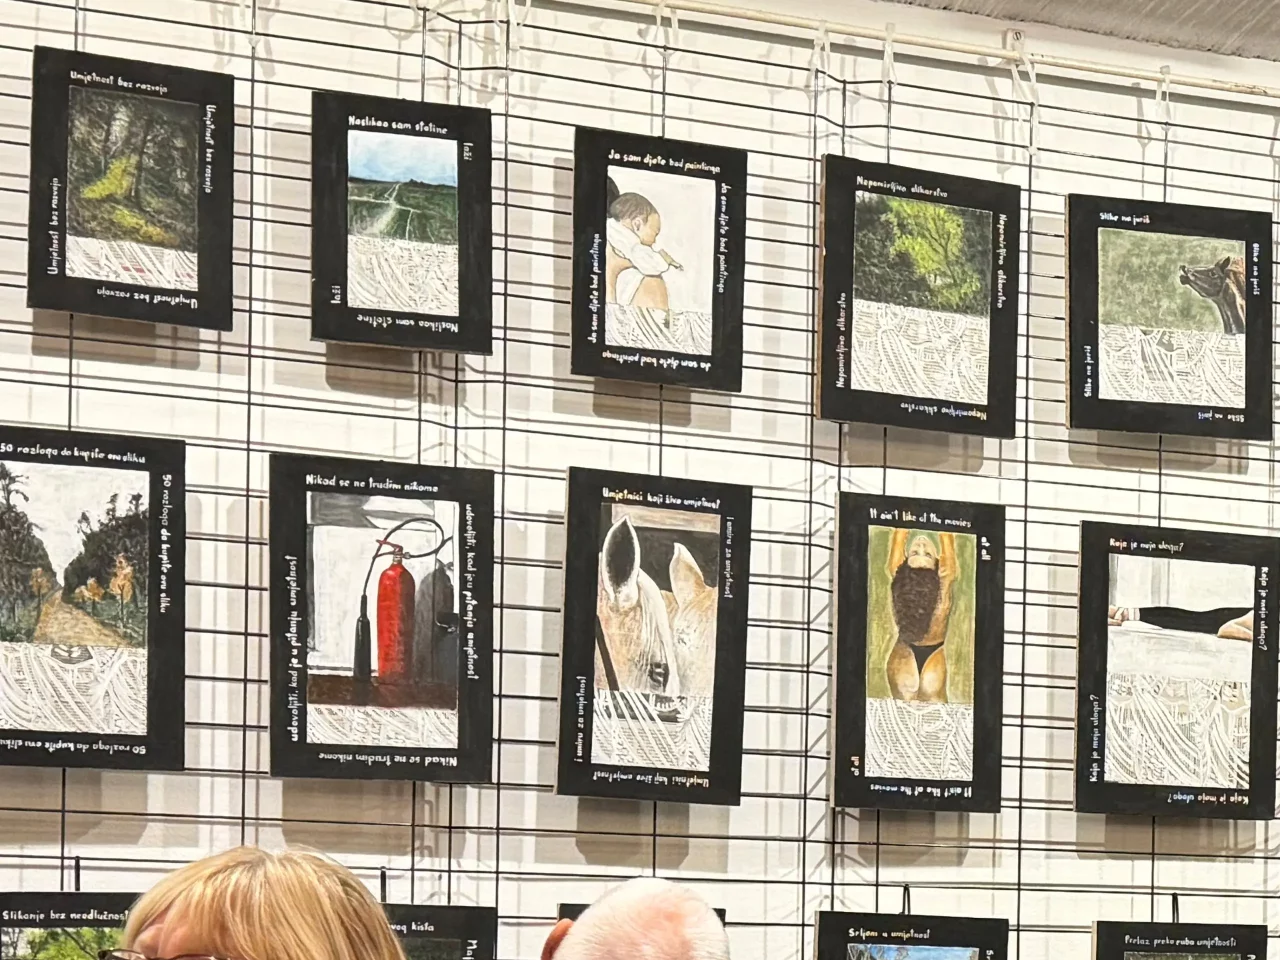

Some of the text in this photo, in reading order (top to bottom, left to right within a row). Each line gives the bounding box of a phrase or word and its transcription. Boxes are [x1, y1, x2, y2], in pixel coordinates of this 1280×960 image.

[70, 70, 114, 85] Umjetnost
[117, 76, 133, 88] bez
[391, 121, 412, 130] sam
[414, 120, 448, 135] stotine
[463, 142, 474, 161] laži
[607, 148, 621, 160] Ja
[622, 153, 642, 163] sam
[48, 210, 59, 226] bez
[46, 230, 62, 275] Umjetnost
[162, 473, 173, 488] 50
[305, 473, 439, 493] Nikad se ne trudim nikome
[602, 486, 643, 502] Umjetnici
[683, 496, 721, 510] umjetnost
[158, 489, 173, 526] razloga
[869, 507, 878, 519] It
[902, 510, 917, 522] like
[929, 512, 942, 525] the
[944, 518, 972, 528] movies
[160, 527, 172, 541] da
[725, 547, 732, 558] za
[980, 536, 992, 561] at all
[1109, 537, 1128, 551] Koja
[1130, 541, 1138, 551] je
[157, 543, 173, 574] kupite
[466, 552, 477, 572] kad
[463, 573, 476, 582] je
[723, 559, 734, 599] umjetnost
[159, 592, 171, 613] sliku
[461, 590, 479, 628] pitanju
[462, 631, 480, 680] umjetnost
[2, 909, 45, 922] Slikanje
[50, 910, 66, 920] bez
[411, 921, 435, 932] kista
[890, 928, 931, 941] umjetnost
[1153, 936, 1175, 948] preko
[1175, 936, 1195, 946] ruba
[1196, 936, 1237, 949] umjetnosti
